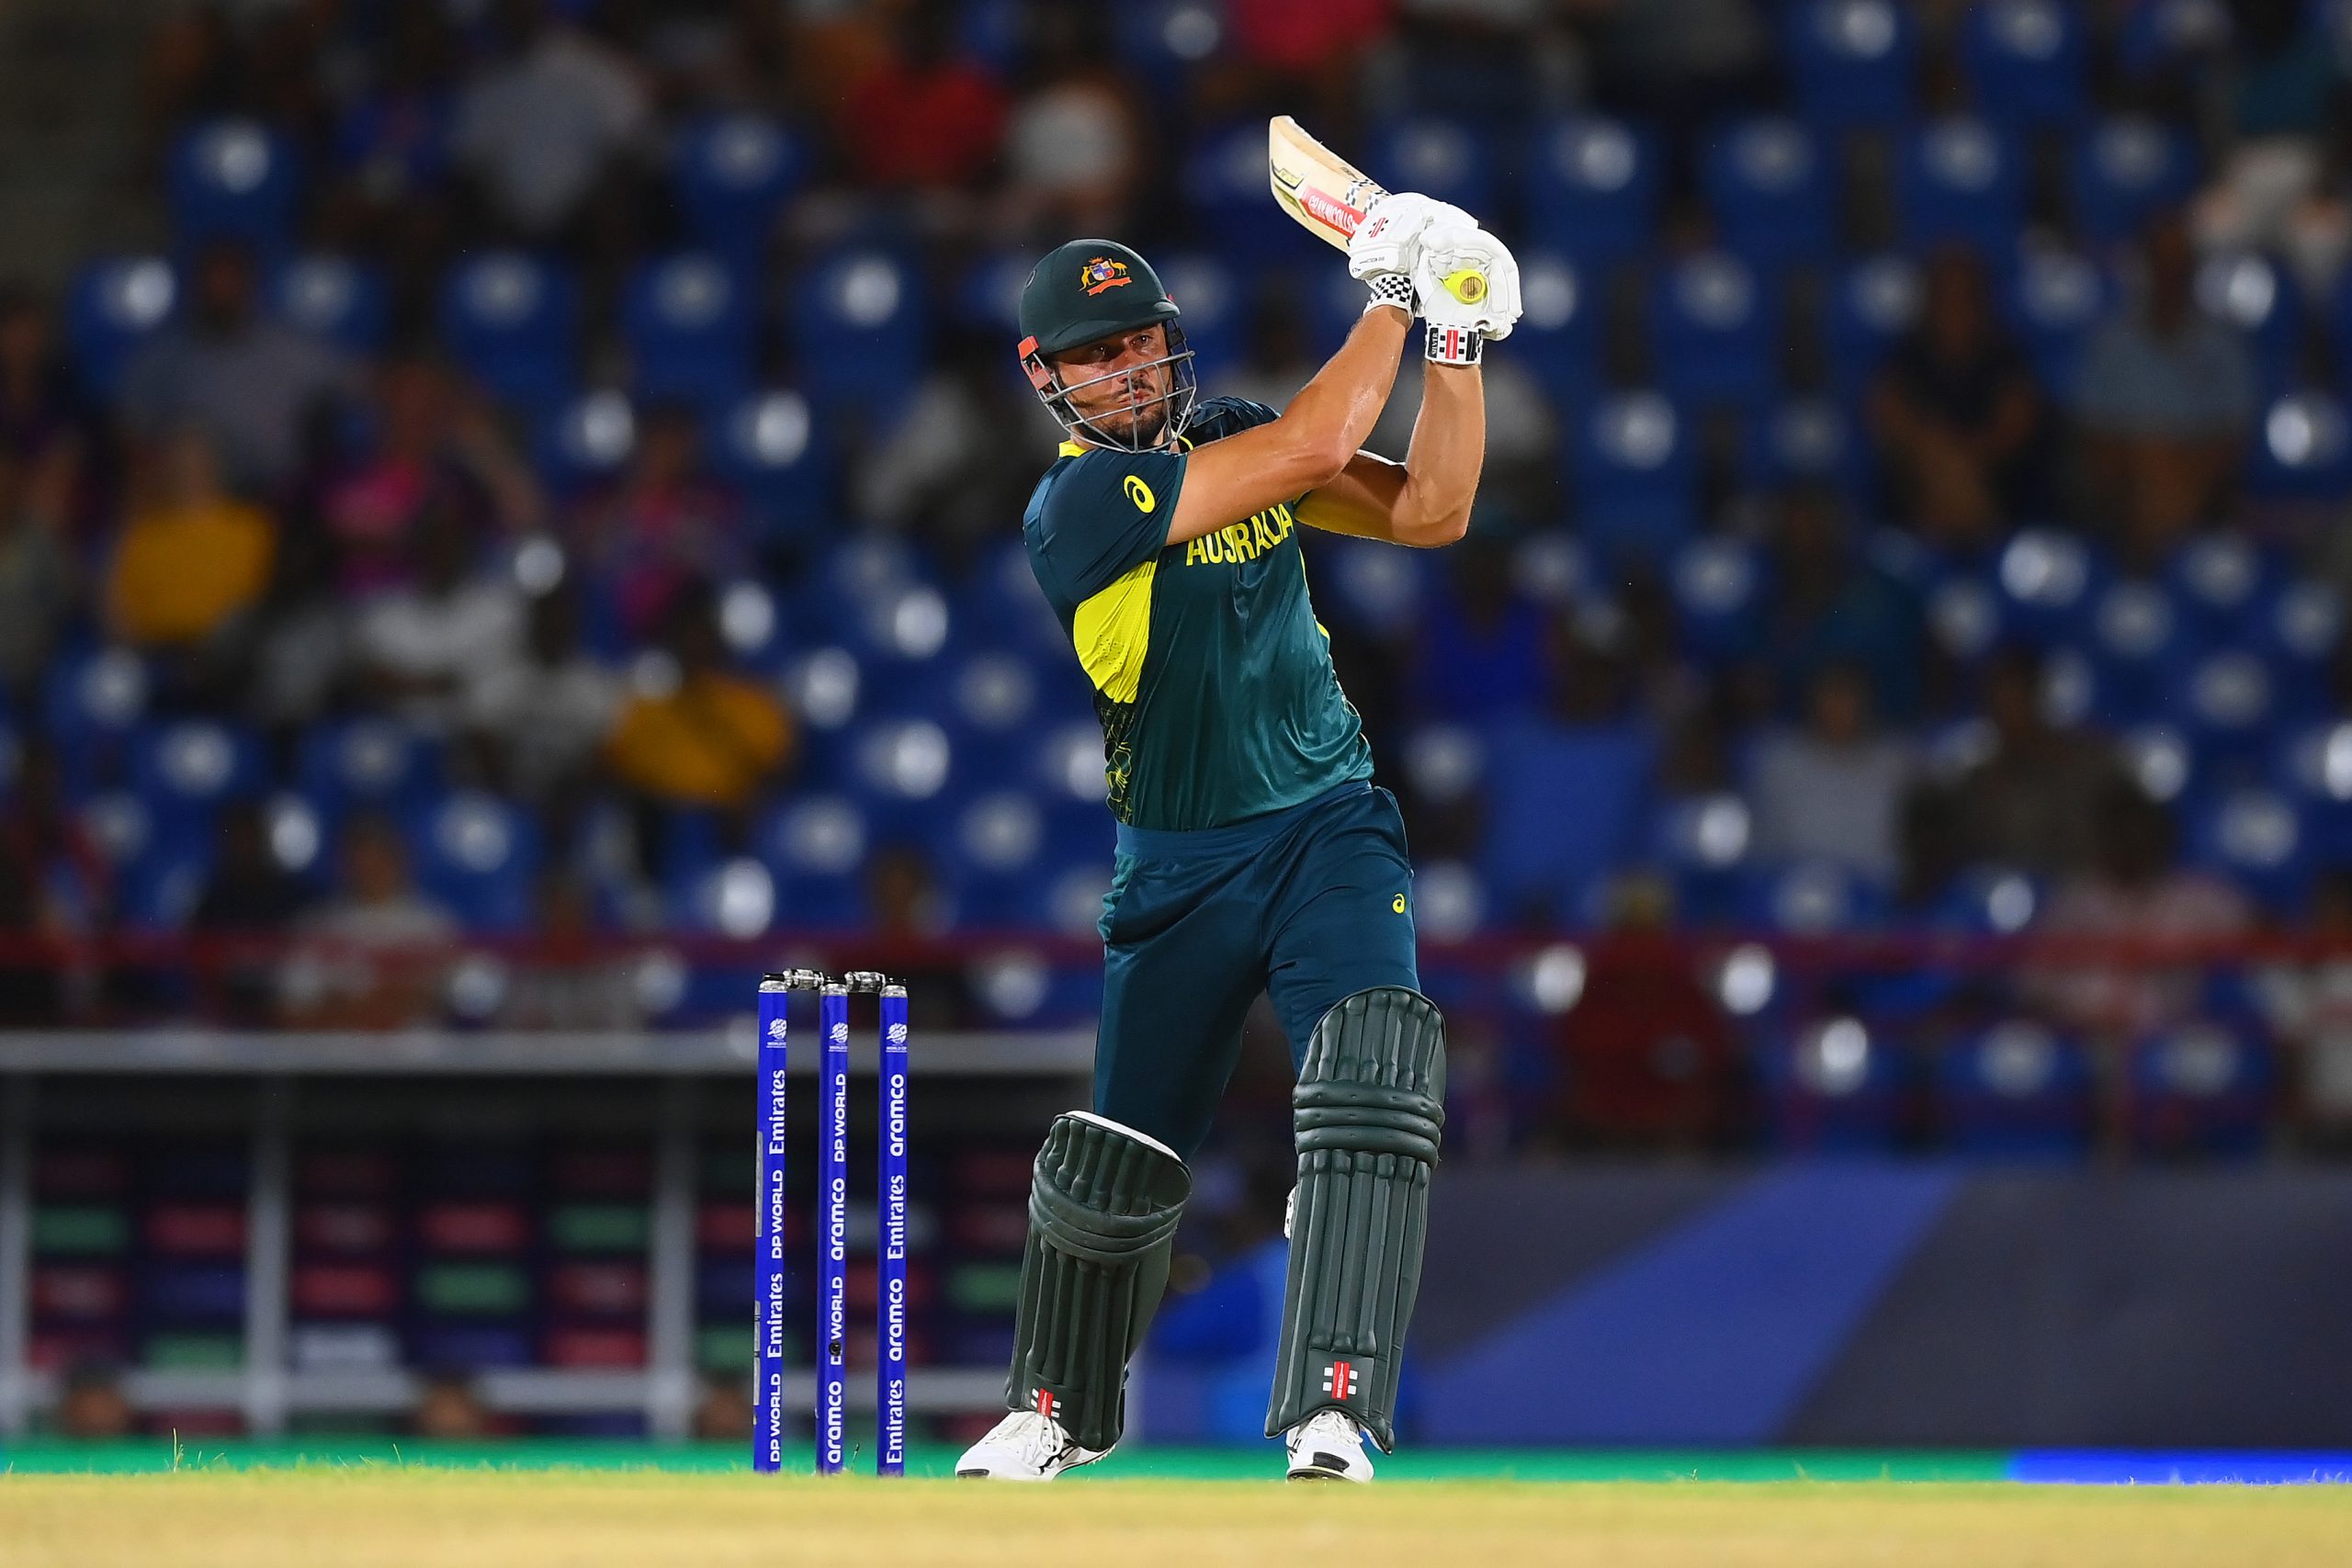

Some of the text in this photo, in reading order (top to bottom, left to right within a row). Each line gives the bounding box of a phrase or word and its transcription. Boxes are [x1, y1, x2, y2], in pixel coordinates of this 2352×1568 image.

[768, 1069, 786, 1155] Emirates
[834, 1073, 846, 1163] DP WORLD
[889, 1074, 905, 1157] aramco
[771, 1169, 784, 1259] DP WORLD
[831, 1178, 845, 1261] aramco
[888, 1174, 904, 1260] Emirates
[767, 1272, 783, 1359] Emirates
[831, 1276, 843, 1340] WORLD
[889, 1278, 903, 1361] aramco
[770, 1372, 782, 1462] DP WORLD
[828, 1381, 842, 1463] aramco
[887, 1379, 903, 1464] Emirates
